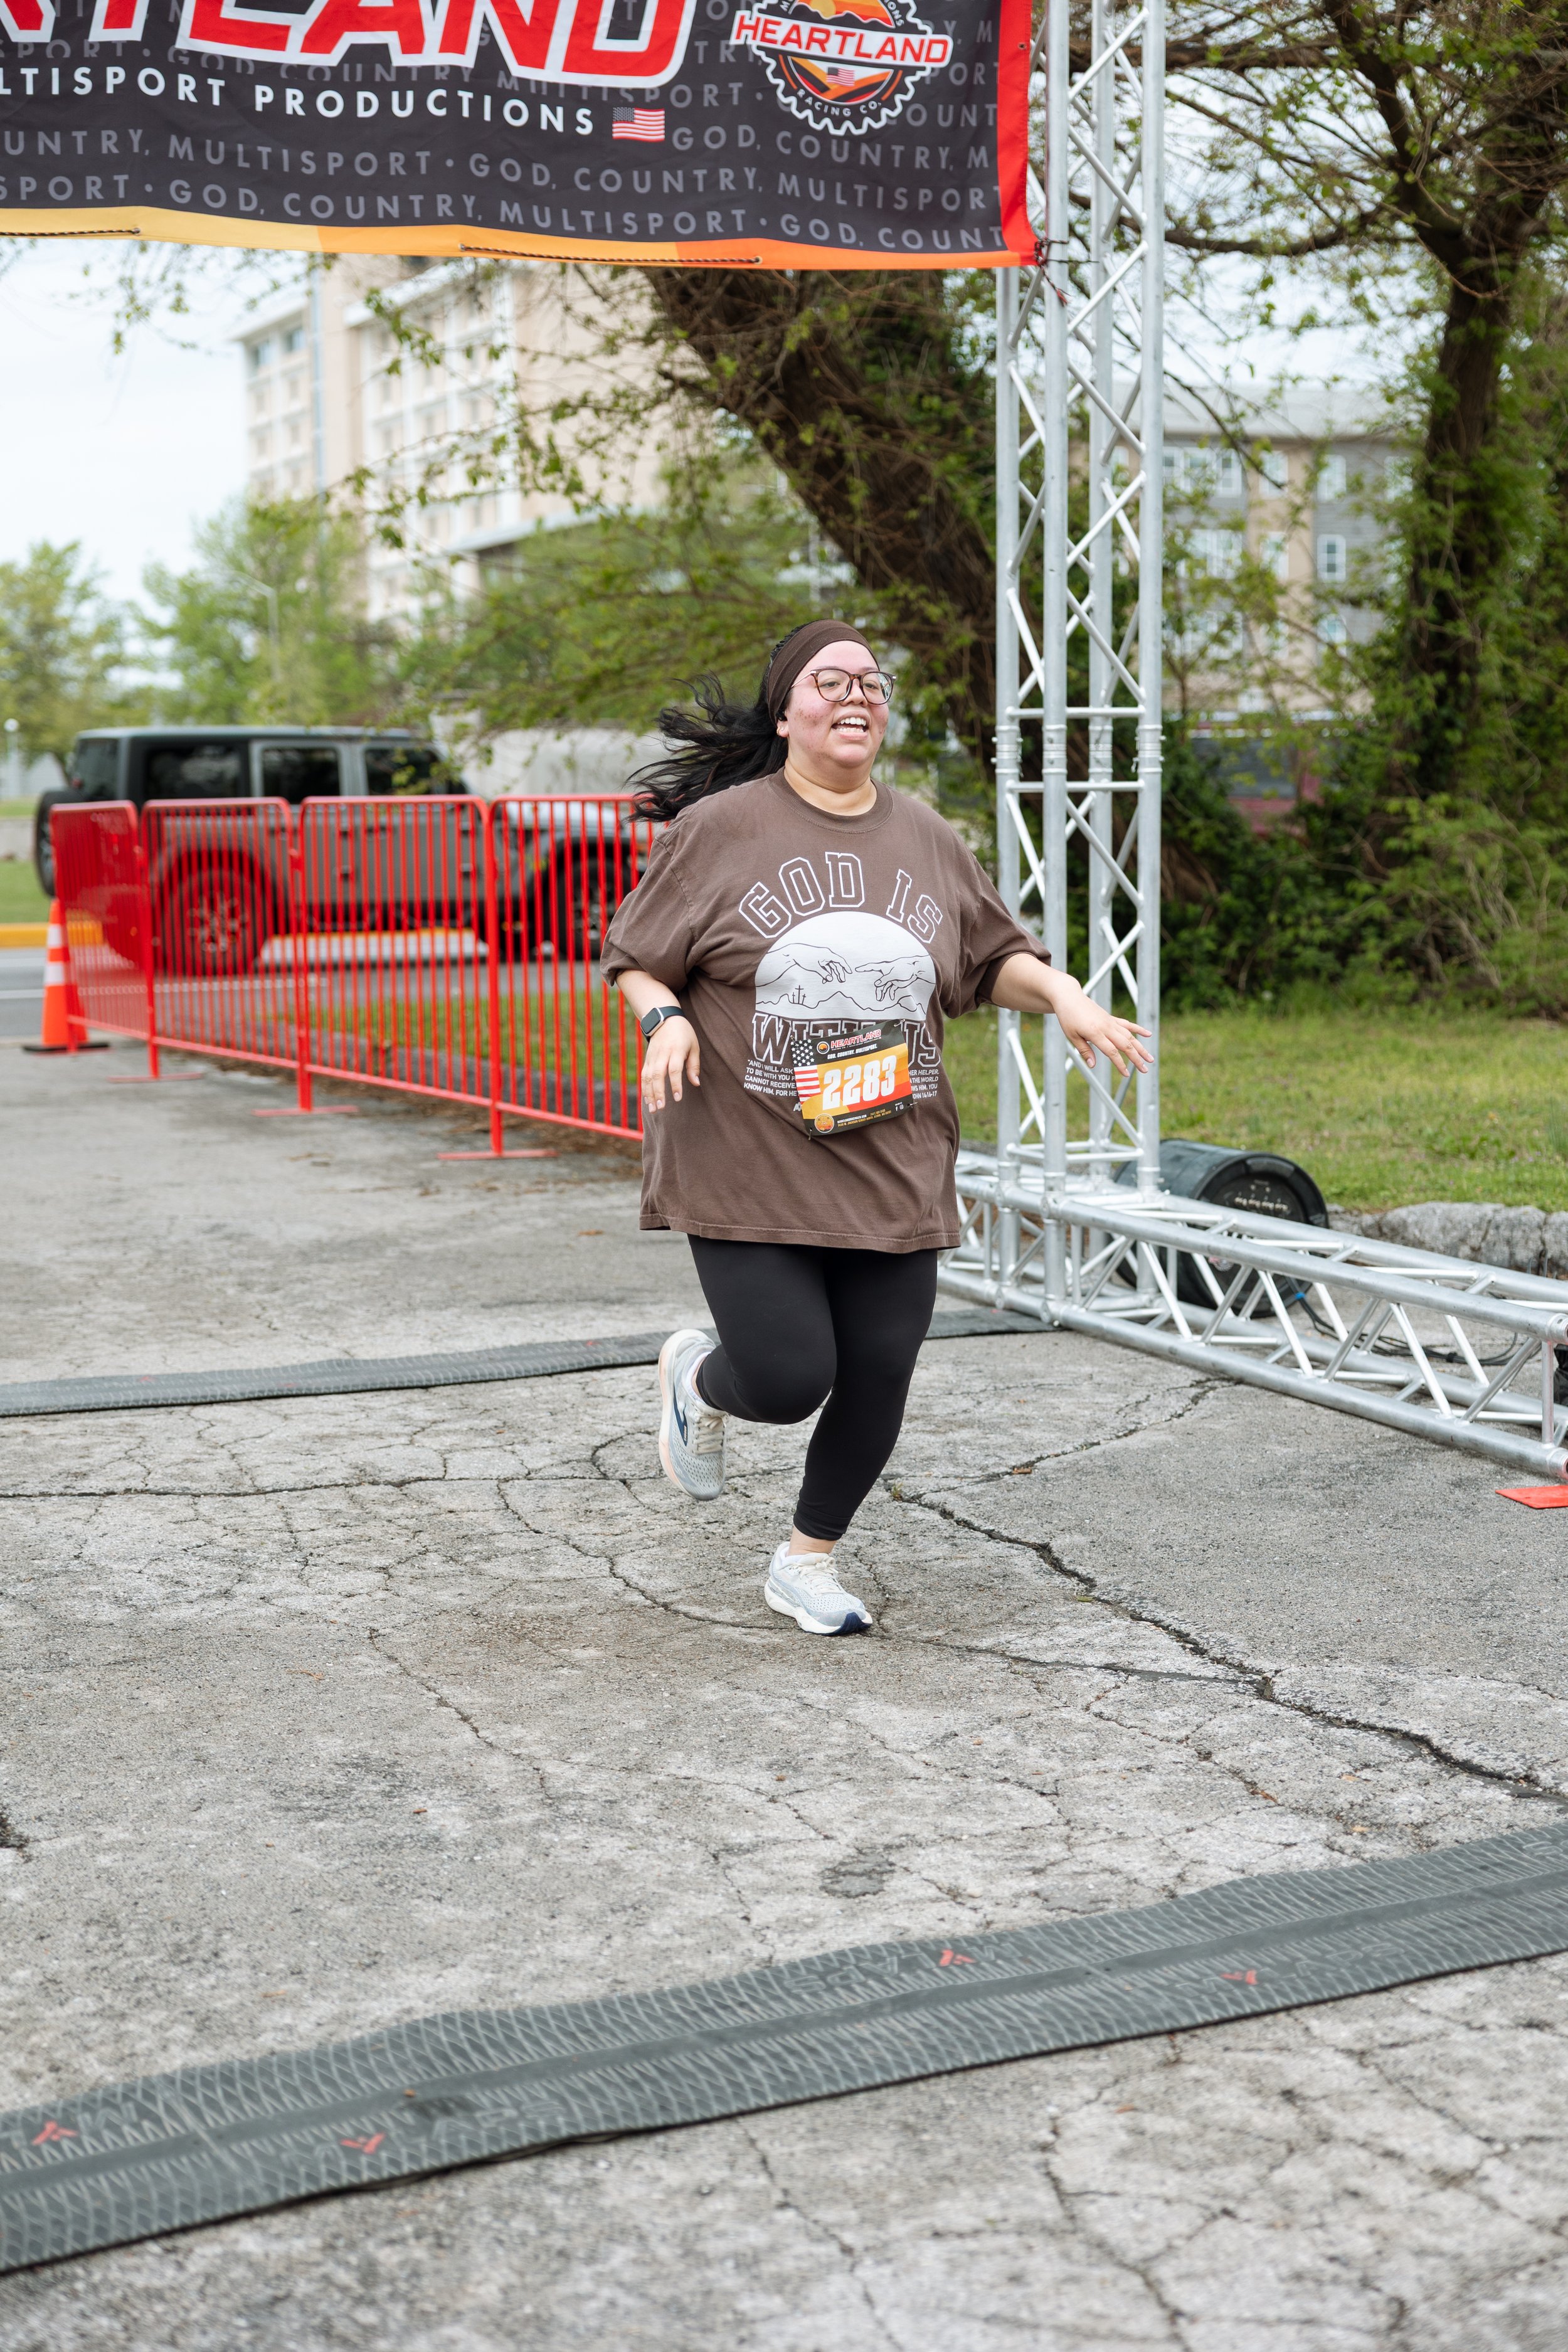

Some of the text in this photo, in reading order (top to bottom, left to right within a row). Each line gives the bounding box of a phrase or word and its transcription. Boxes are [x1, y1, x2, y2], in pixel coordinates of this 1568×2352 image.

[734, 14, 950, 63] HEARTLAND
[254, 84, 594, 135] PRODUCTIONS
[797, 88, 852, 117] RACING
[859, 100, 882, 114] CO.
[168, 134, 431, 176] MULTISPORT
[469, 152, 556, 189] GOD,
[573, 166, 763, 194] COUNTRY,
[672, 124, 761, 151] GOD,
[775, 130, 954, 171] COUNTRY,
[169, 179, 264, 215] GOD,
[282, 192, 482, 221] COUNTRY,
[499, 199, 746, 235] MULTISPORT
[738, 851, 943, 944] GOD IS
[830, 1029, 882, 1049] HEARTLAND
[743, 1083, 763, 1092] KNOW
[744, 1075, 770, 1086] CANNOT
[763, 1071, 776, 1079] WITH
[822, 1054, 898, 1111] 2283
